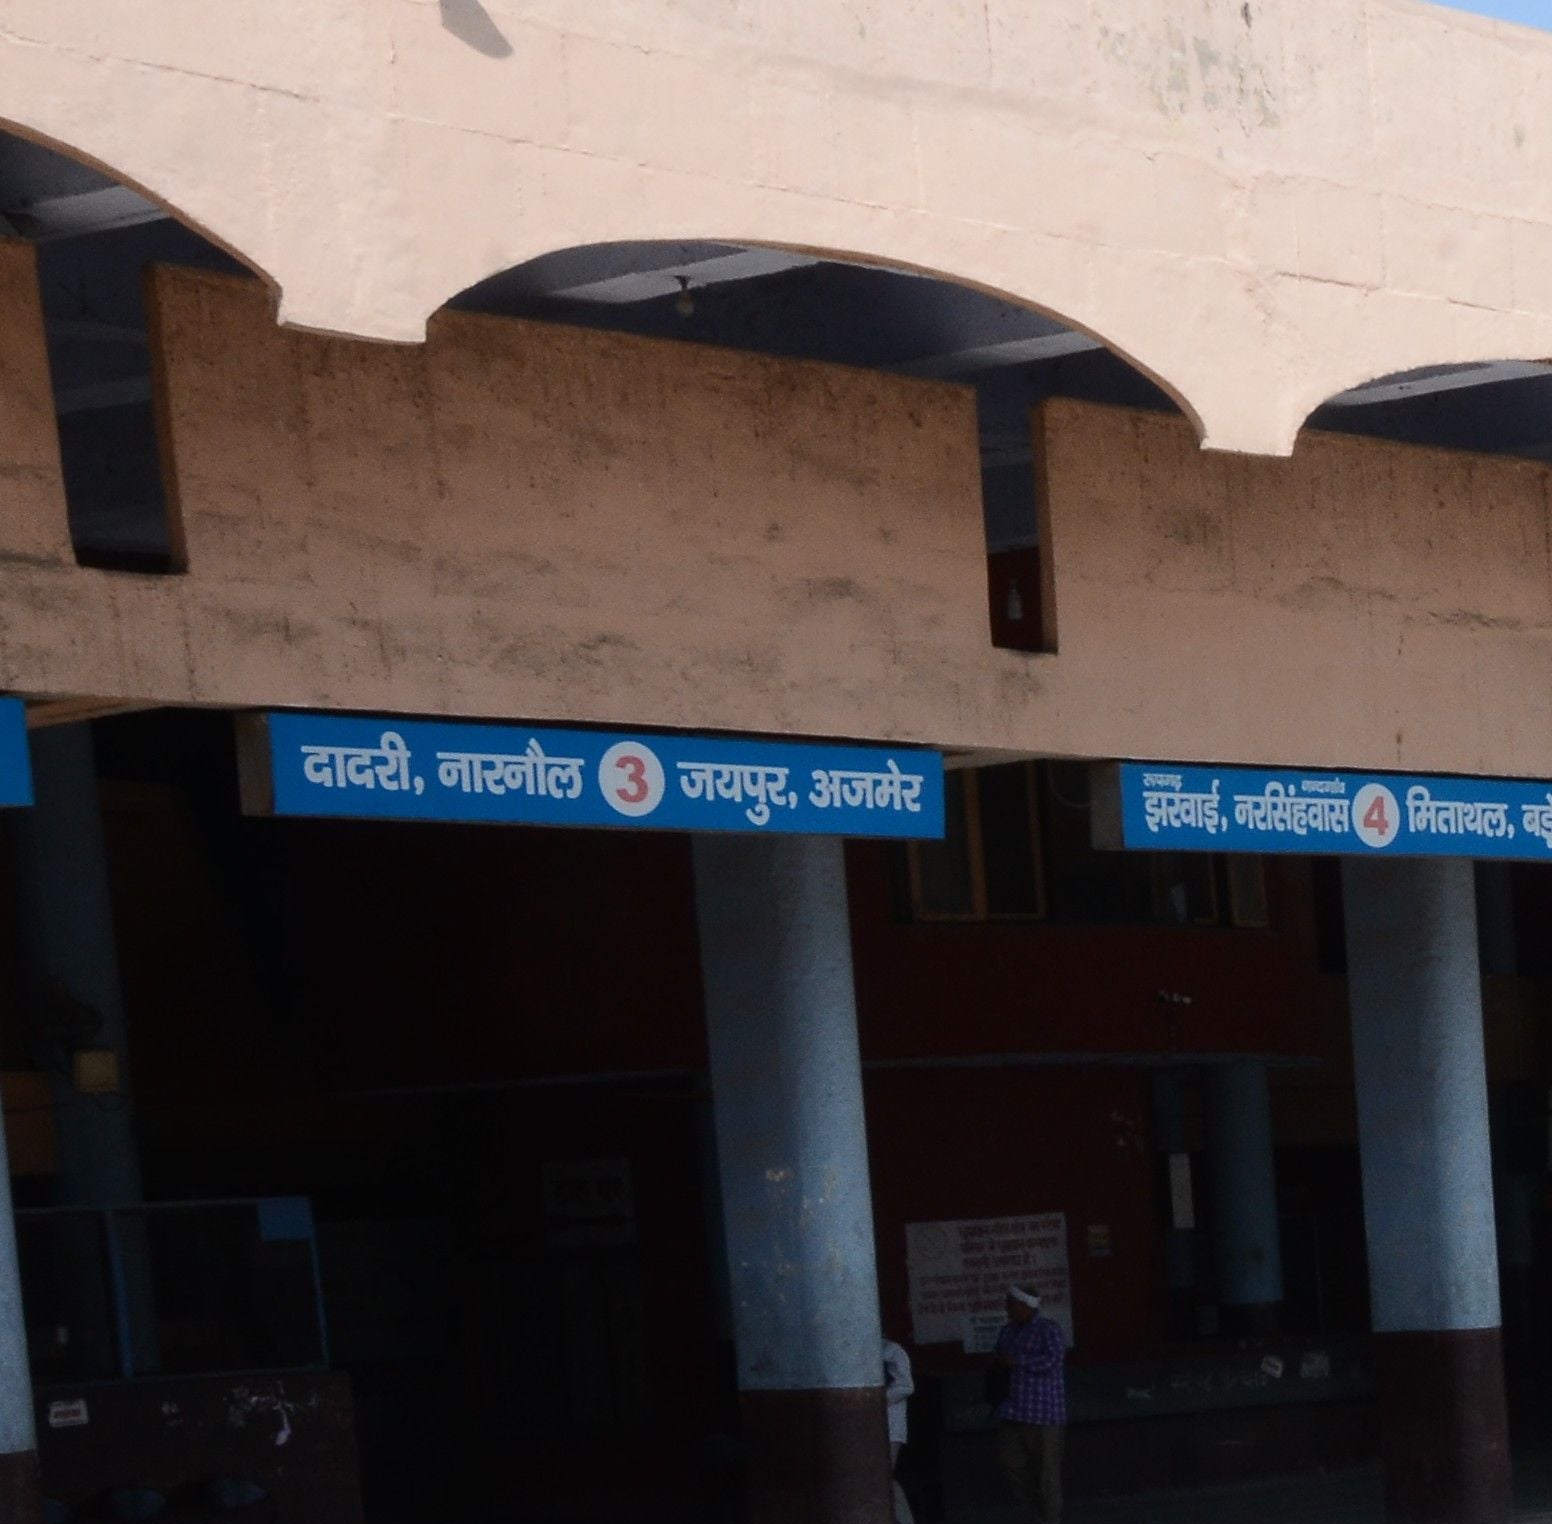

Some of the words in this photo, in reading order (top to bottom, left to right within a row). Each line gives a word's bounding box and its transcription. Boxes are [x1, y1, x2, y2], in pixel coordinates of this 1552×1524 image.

[302, 732, 423, 796] दादरी,
[437, 738, 584, 799] नारनौल
[615, 755, 648, 803] 3
[677, 761, 797, 825] जयपुर,
[808, 759, 922, 812] अजमेर
[1143, 779, 1228, 834] झरवाई,
[1234, 781, 1349, 837] नरसिंहवास
[1363, 795, 1389, 836] 4
[1406, 785, 1515, 839] मिताथल,
